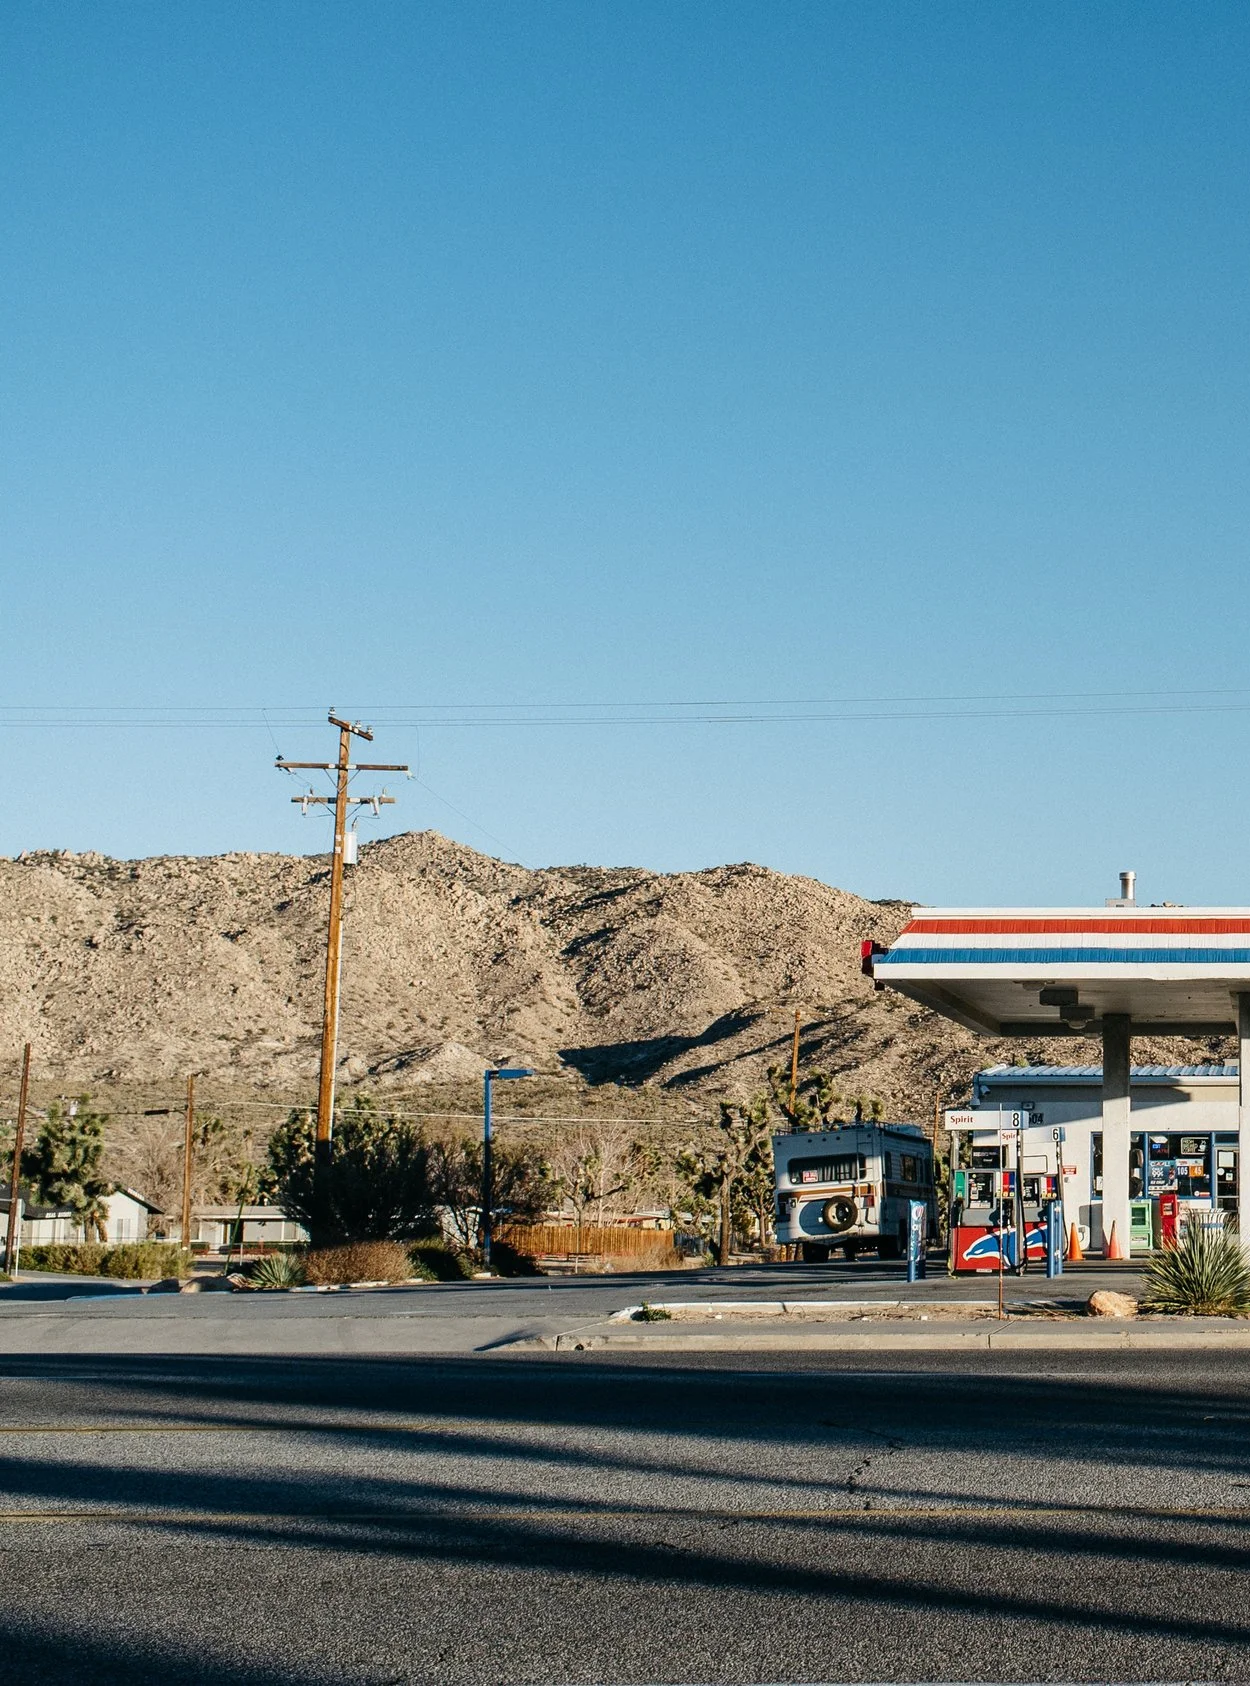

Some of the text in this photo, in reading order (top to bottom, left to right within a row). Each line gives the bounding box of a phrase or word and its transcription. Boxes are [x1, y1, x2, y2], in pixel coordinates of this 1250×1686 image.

[950, 1115, 974, 1126] Spirit
[1012, 1112, 1020, 1127] 8
[1052, 1128, 1059, 1141] 6
[1177, 1166, 1189, 1176] 105
